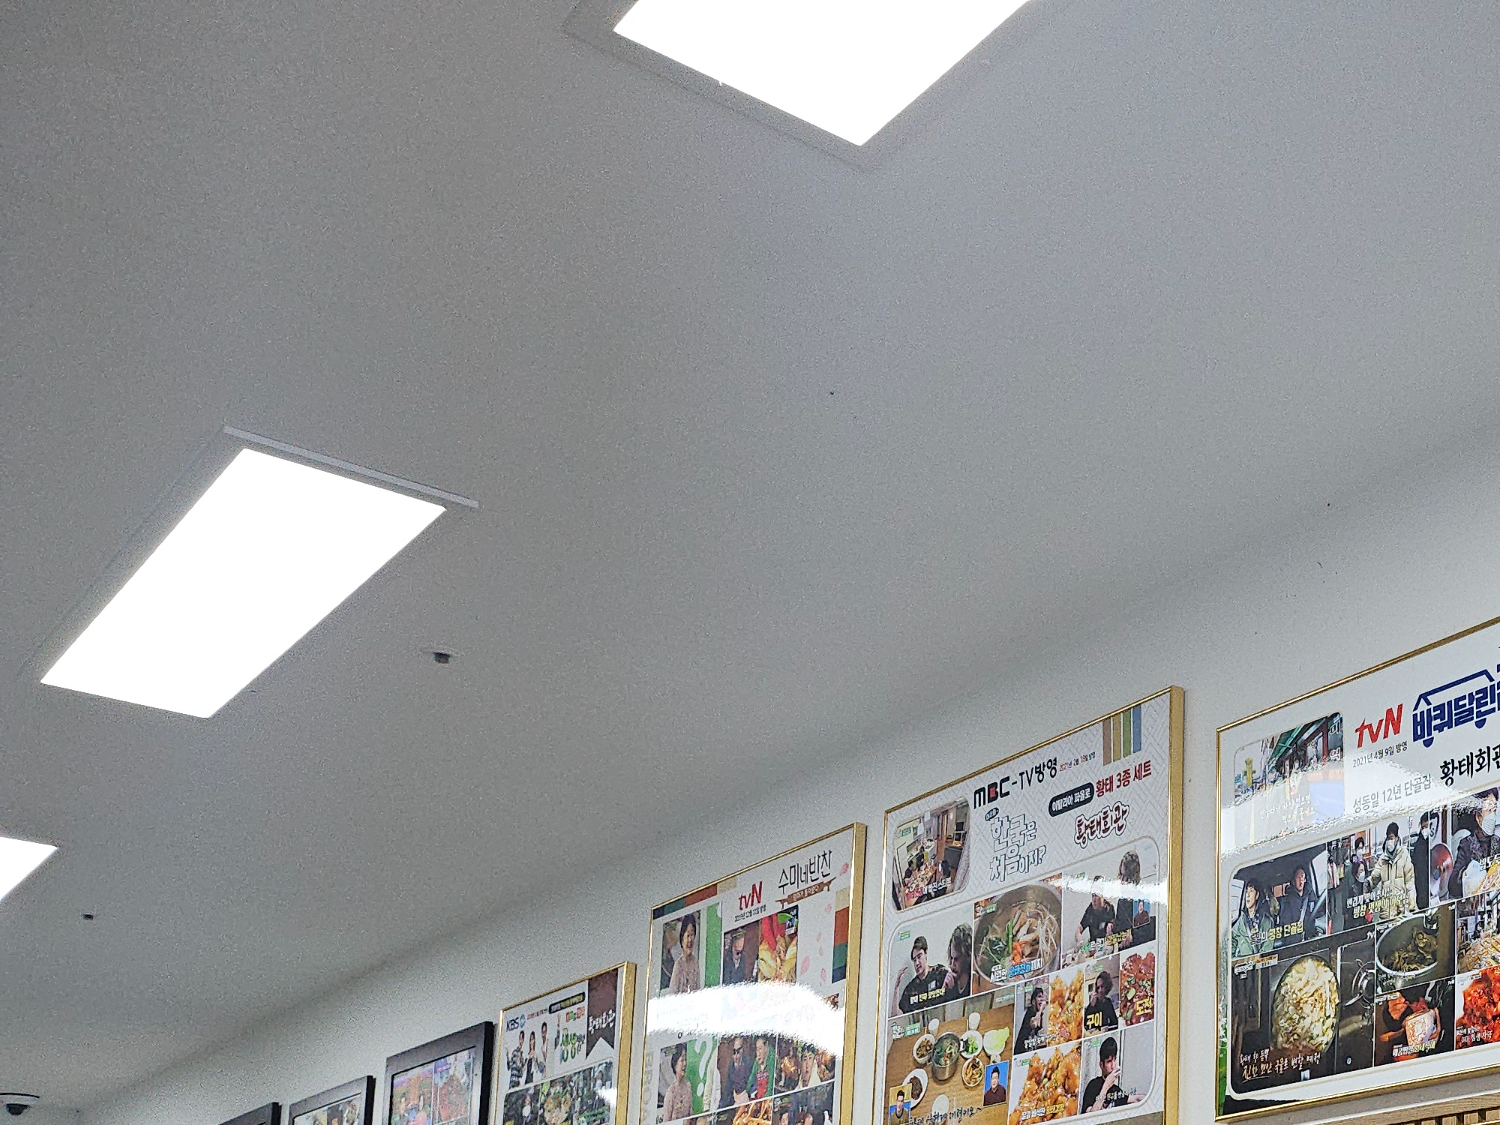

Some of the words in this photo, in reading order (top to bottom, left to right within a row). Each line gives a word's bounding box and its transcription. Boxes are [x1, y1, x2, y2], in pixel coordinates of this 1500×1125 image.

[1355, 703, 1404, 749] tvN
[1352, 752, 1374, 768] 2021년
[1395, 740, 1408, 754] 방영
[1096, 775, 1114, 798] 황태
[1116, 769, 1132, 790] 3종
[1133, 760, 1152, 781] 세트
[1352, 790, 1380, 814] 성동일
[1381, 783, 1402, 804] 12년
[1404, 773, 1432, 797] 단골집
[1076, 803, 1129, 845] 황태회관
[738, 881, 763, 911] tvN
[778, 850, 833, 895] 수미네반찬
[505, 1016, 519, 1033] KBS
[1086, 1011, 1103, 1029] 구이
